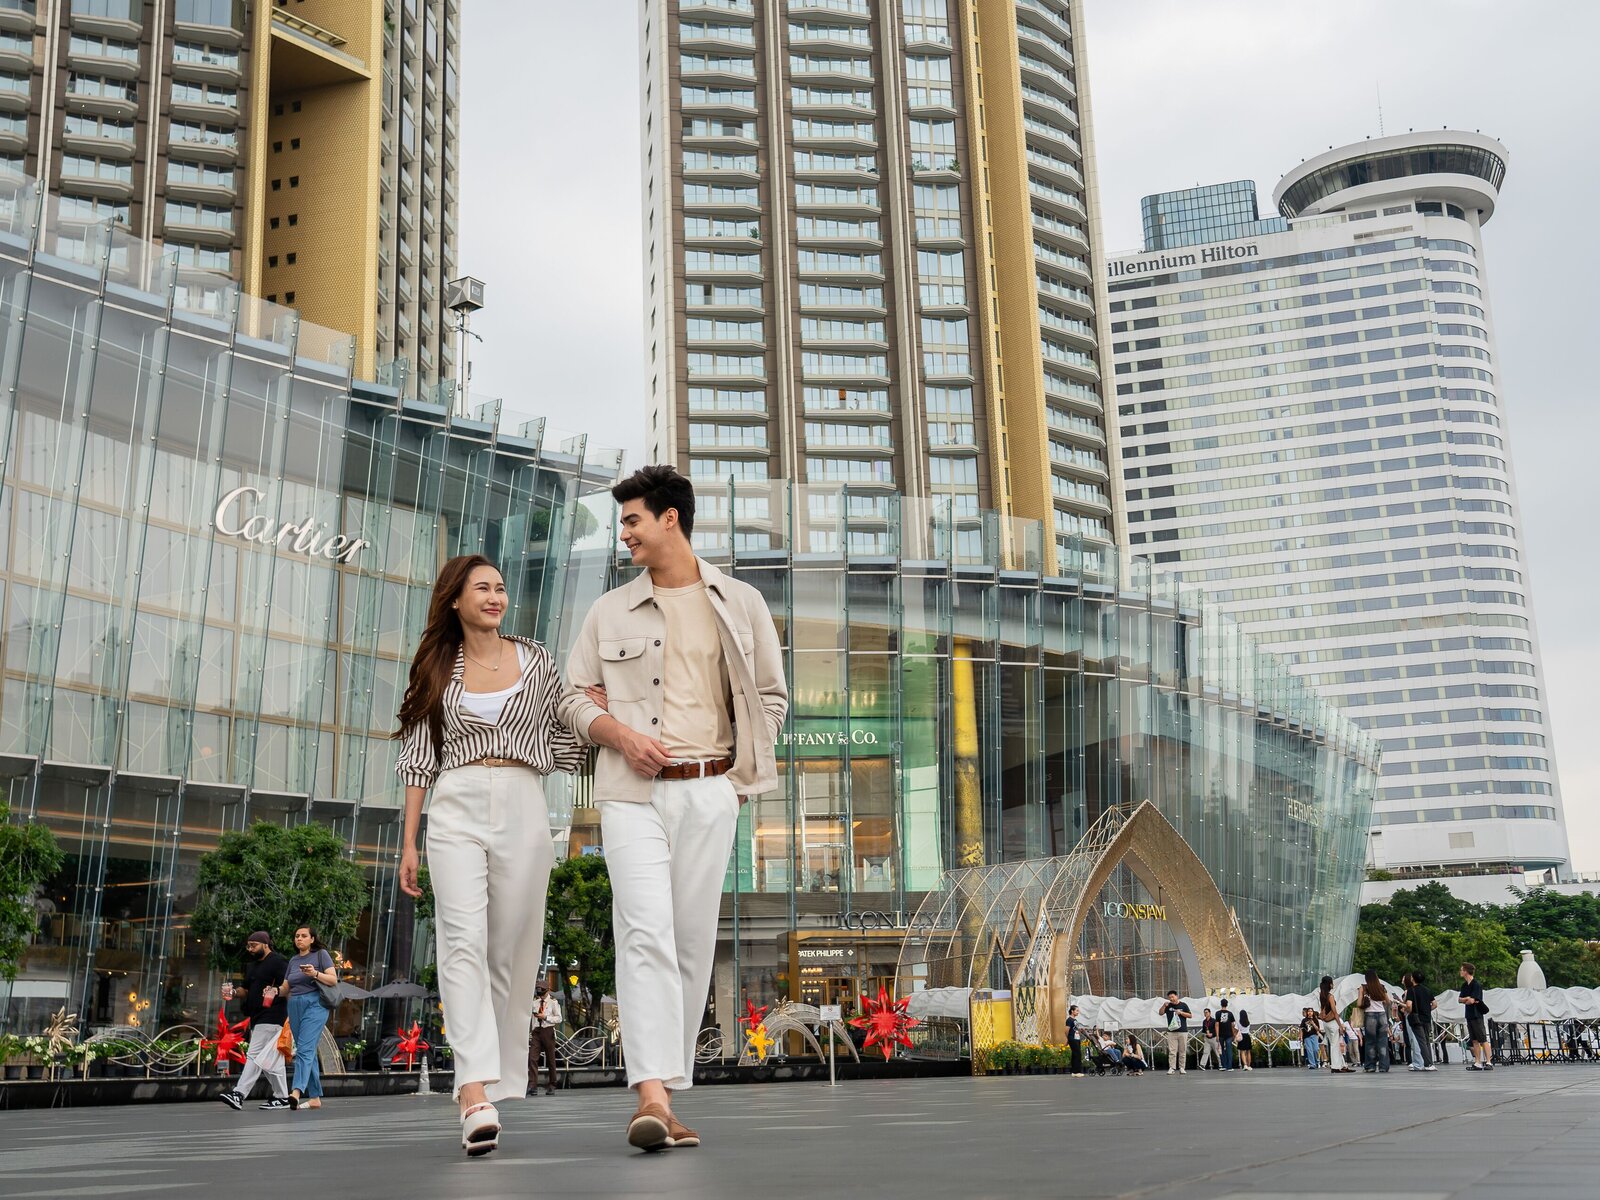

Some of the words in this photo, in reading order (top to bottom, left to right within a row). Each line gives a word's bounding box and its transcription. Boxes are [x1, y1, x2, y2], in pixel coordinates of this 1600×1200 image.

[1108, 253, 1196, 277] illennium
[1201, 244, 1259, 264] Hilton
[215, 486, 371, 563] Cartier
[1103, 901, 1167, 921] ICONSIAM
[798, 950, 816, 958] PATEK
[816, 949, 844, 957] PHILIPPE
